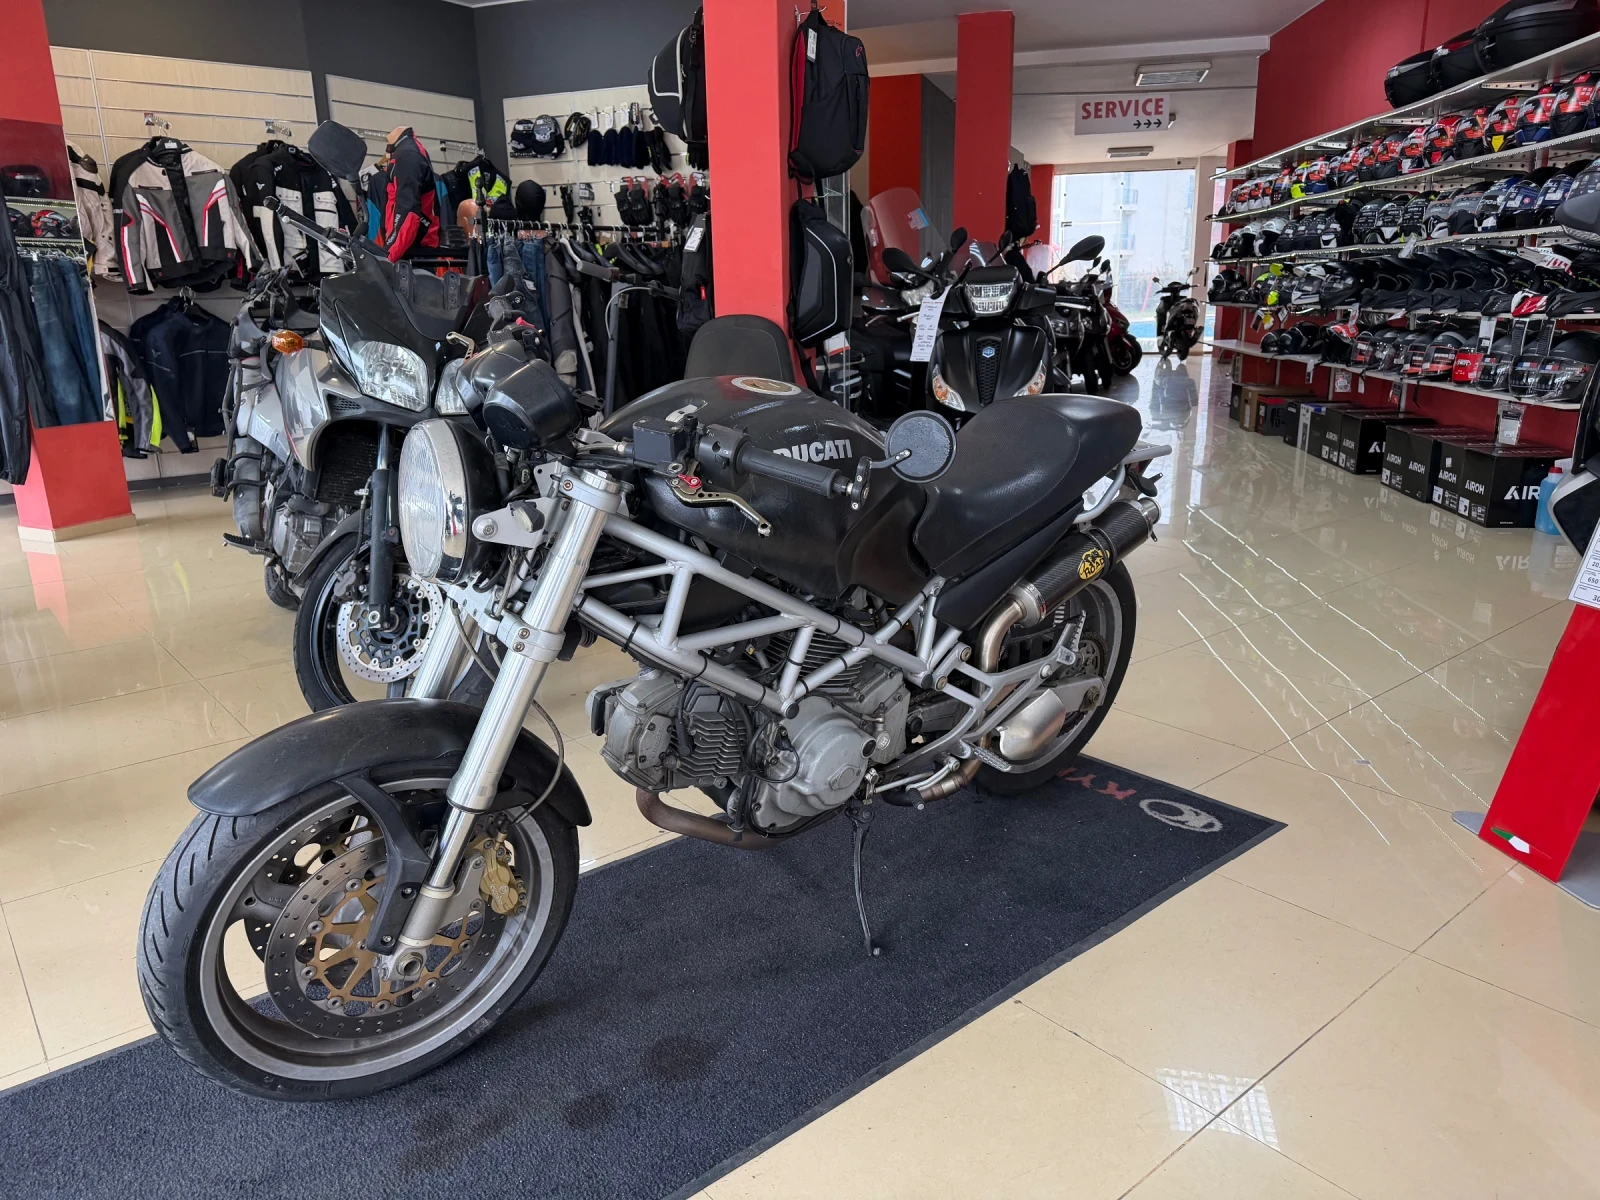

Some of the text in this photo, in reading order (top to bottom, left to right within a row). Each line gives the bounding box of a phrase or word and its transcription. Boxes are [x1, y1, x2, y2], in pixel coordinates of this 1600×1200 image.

[1081, 97, 1164, 120] SERVICE
[1386, 452, 1402, 466] AIROH
[1408, 460, 1426, 475] AIROH
[1438, 469, 1457, 484] AIROH
[1464, 479, 1485, 495] AIROH
